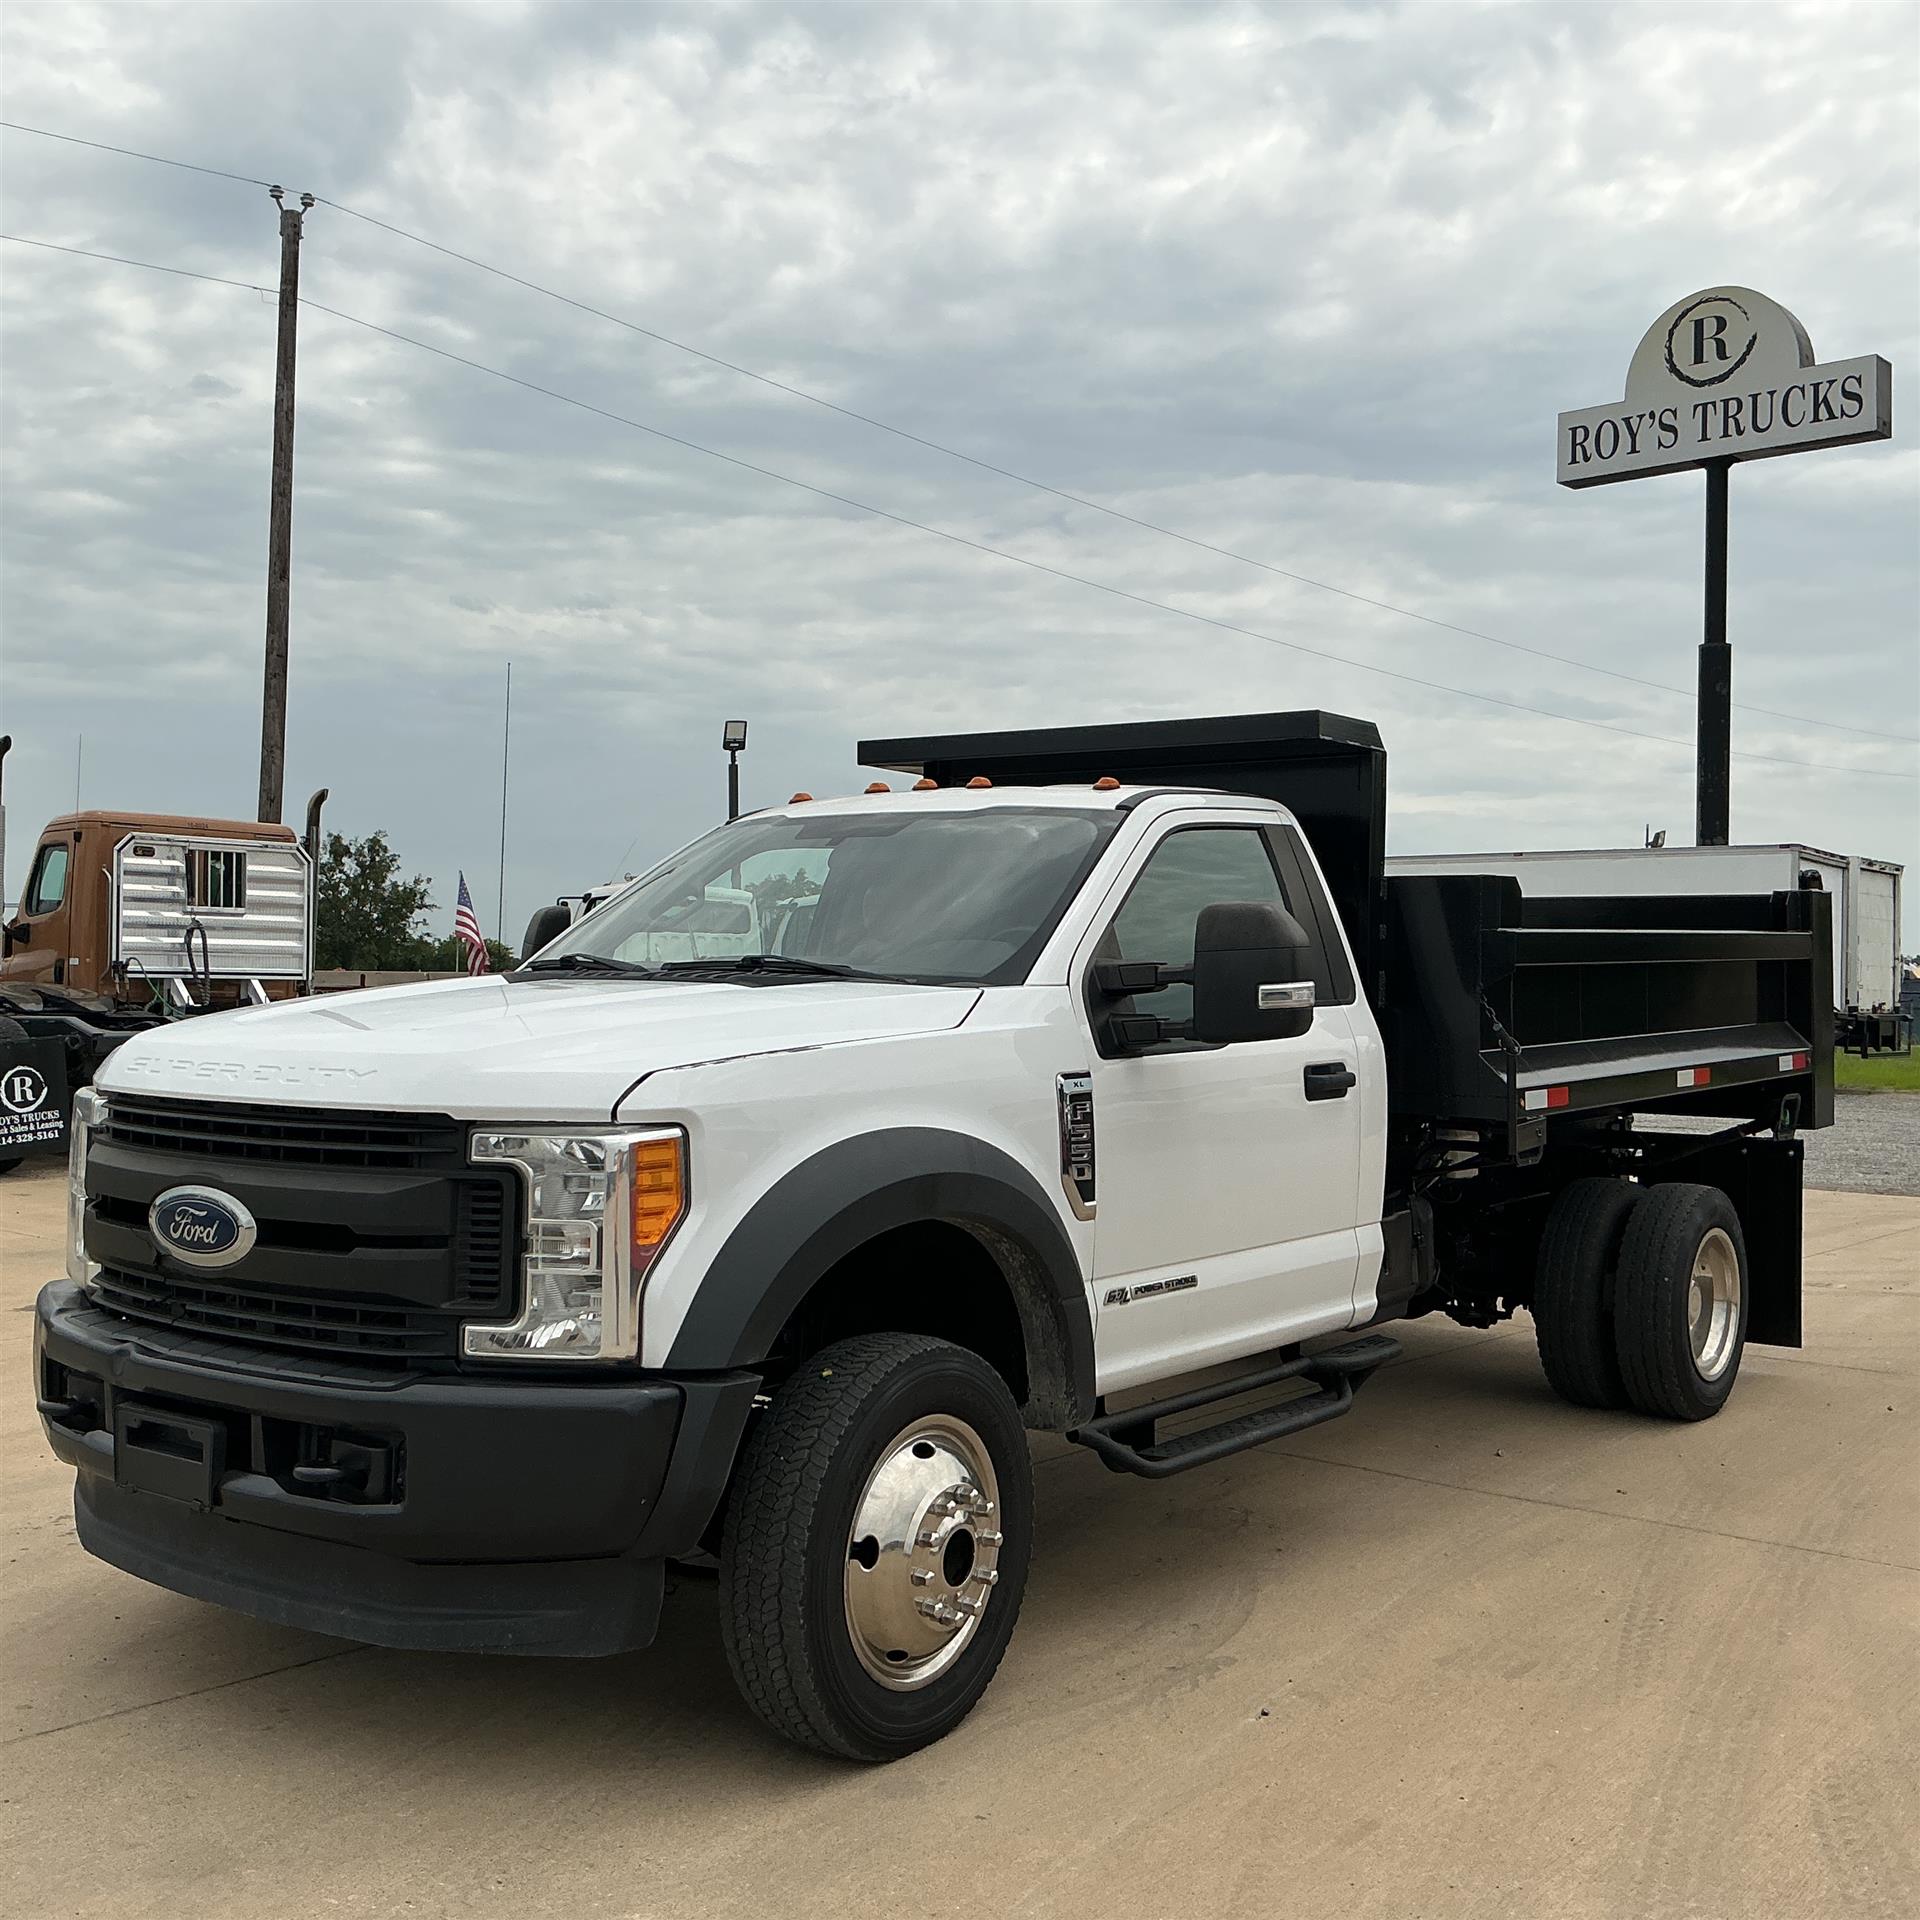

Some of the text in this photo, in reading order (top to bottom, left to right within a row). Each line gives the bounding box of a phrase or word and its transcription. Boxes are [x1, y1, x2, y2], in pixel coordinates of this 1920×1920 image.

[1688, 315, 1732, 366] R
[1567, 374, 1864, 465] ROY'S TRUCKS
[12, 1076, 36, 1102] R
[0, 1109, 60, 1126] OY'S TRUCKS
[9, 1123, 28, 1134] Sales
[29, 1122, 35, 1130] &
[36, 1119, 64, 1129] Leasing
[0, 1129, 60, 1145] 14-328-5161
[169, 1206, 219, 1244] Ford
[1133, 1283, 1164, 1295] POWER
[1164, 1275, 1196, 1289] STROKE
